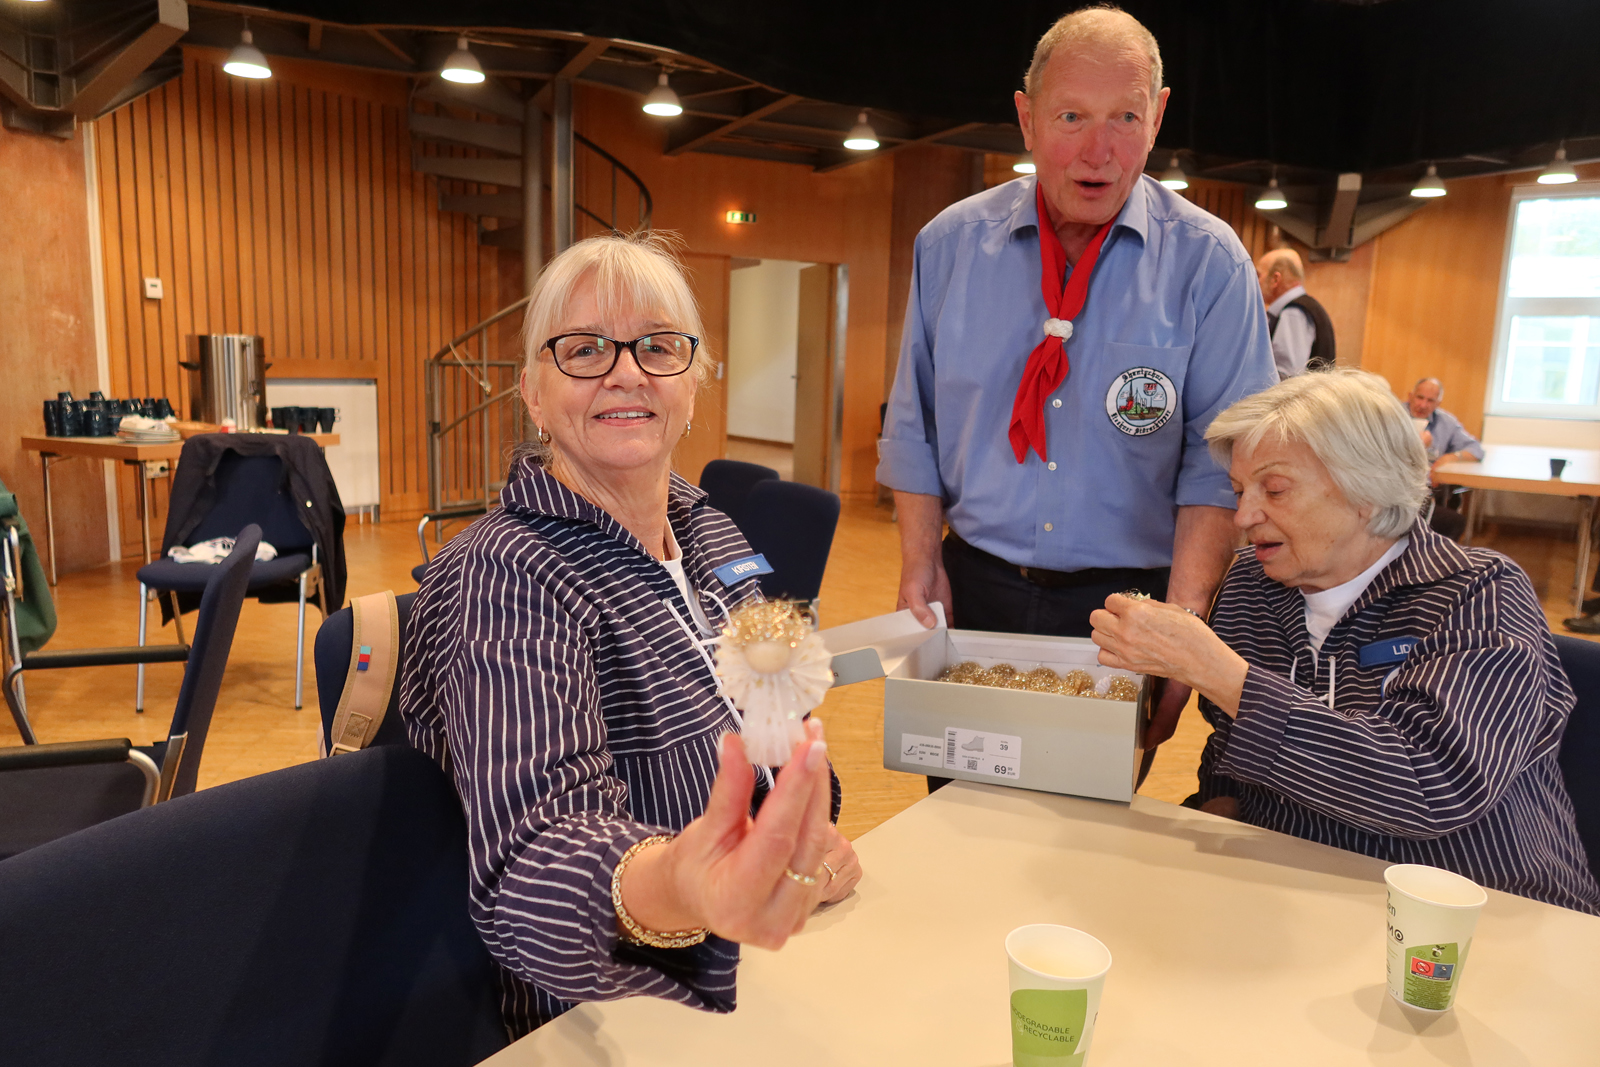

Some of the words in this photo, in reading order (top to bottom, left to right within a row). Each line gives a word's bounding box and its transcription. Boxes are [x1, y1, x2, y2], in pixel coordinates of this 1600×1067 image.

[731, 562, 759, 575] KIRSTEN
[1392, 643, 1412, 656] LID
[999, 743, 1009, 751] 39
[994, 764, 1007, 775] 69
[1023, 1024, 1075, 1043] RECYCLABLE
